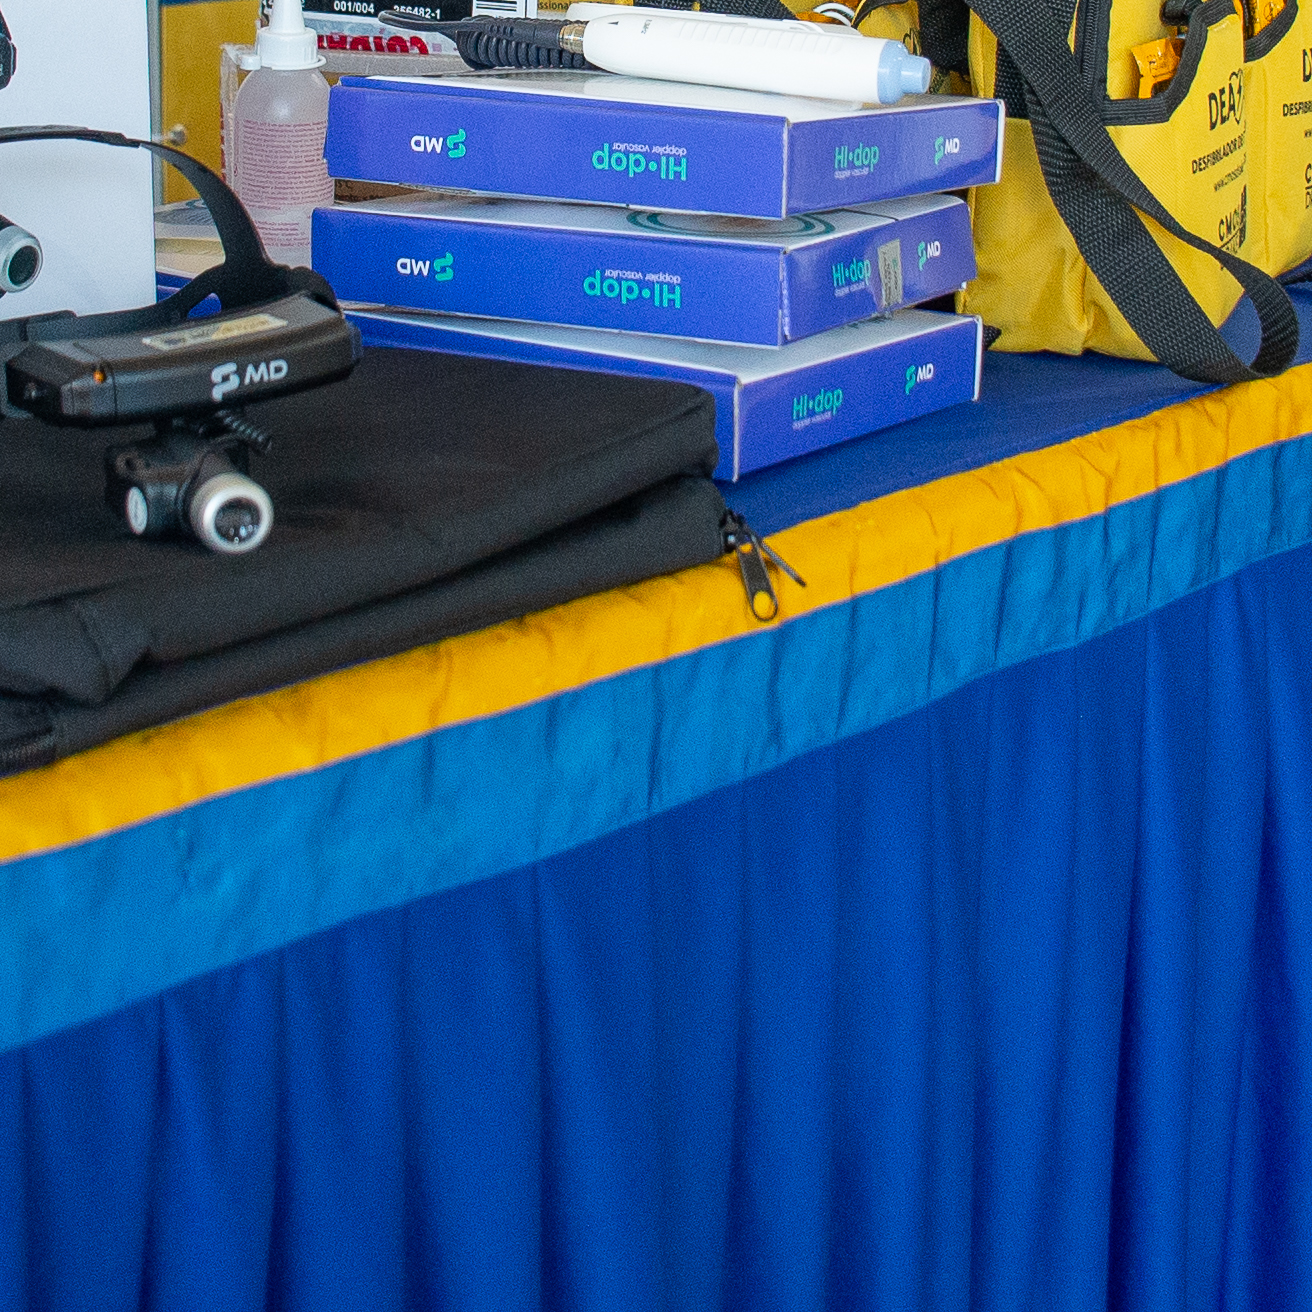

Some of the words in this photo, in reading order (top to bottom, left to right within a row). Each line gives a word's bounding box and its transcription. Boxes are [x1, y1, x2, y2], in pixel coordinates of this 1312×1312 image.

[333, 0, 375, 14] 001/004
[1208, 87, 1235, 131] DEA
[410, 134, 444, 154] MD
[612, 142, 650, 155] vascular
[652, 144, 687, 157] doppler
[945, 138, 960, 155] MD
[1192, 138, 1237, 175] DESFIBRILADOR
[927, 240, 941, 258] MD
[396, 257, 430, 276] MD
[605, 269, 643, 281] vascular
[645, 272, 681, 285] doppler
[244, 358, 288, 386] MD
[917, 363, 934, 381] MD
